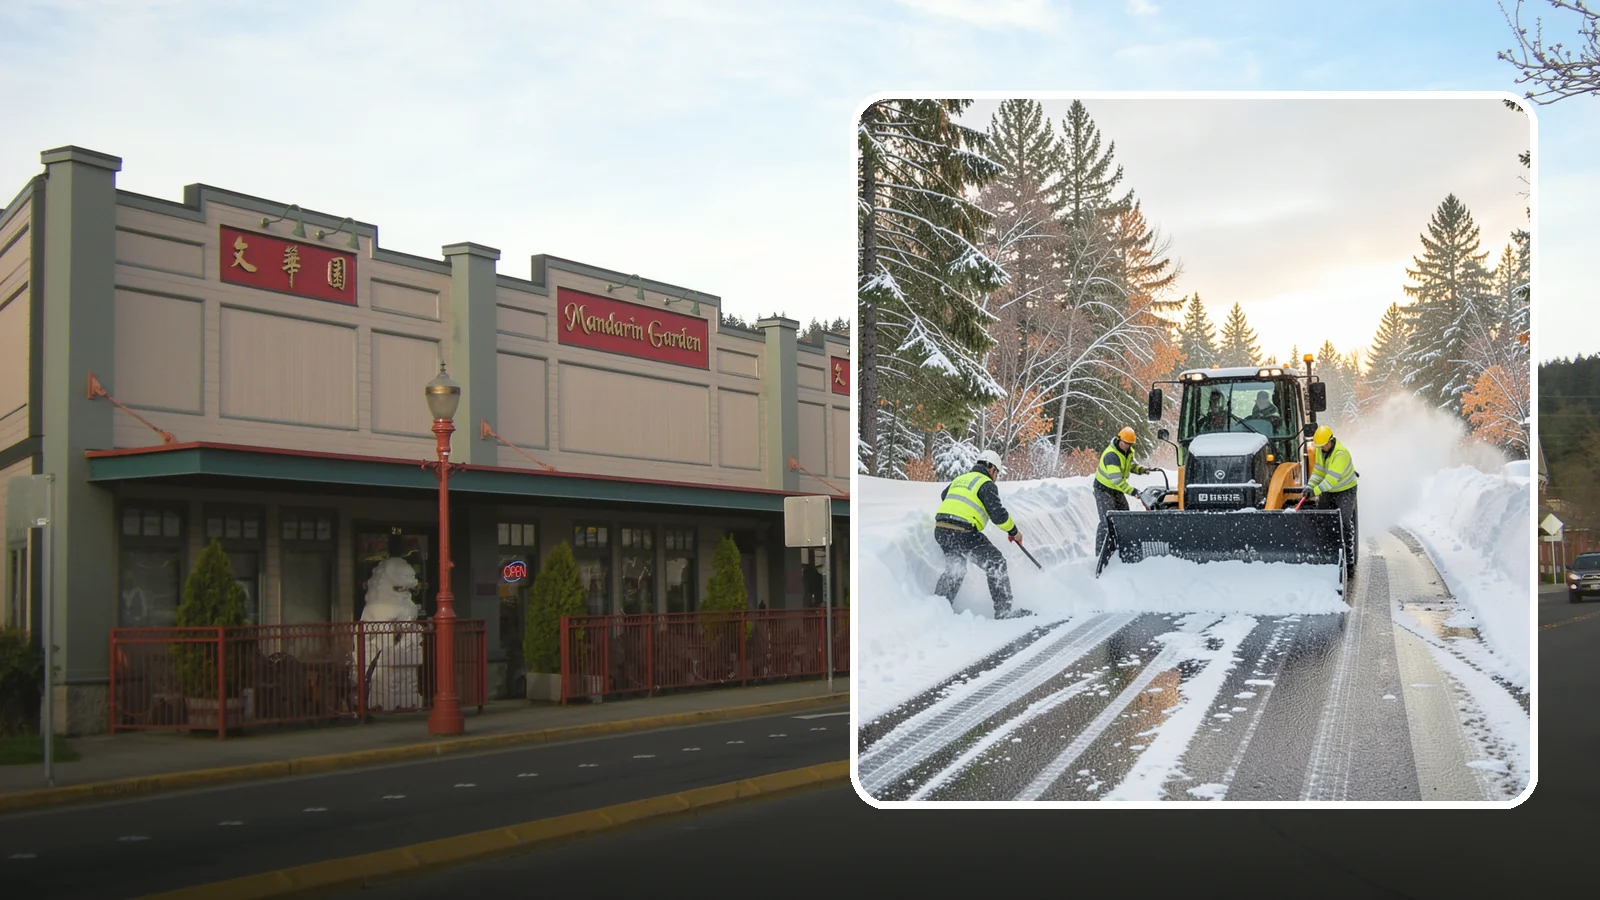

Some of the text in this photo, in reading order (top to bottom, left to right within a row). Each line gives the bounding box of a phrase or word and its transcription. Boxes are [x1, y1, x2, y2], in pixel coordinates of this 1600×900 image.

[230, 235, 347, 292] 文華園
[564, 302, 701, 352] Mandarin Garden
[503, 565, 527, 578] OPEN
